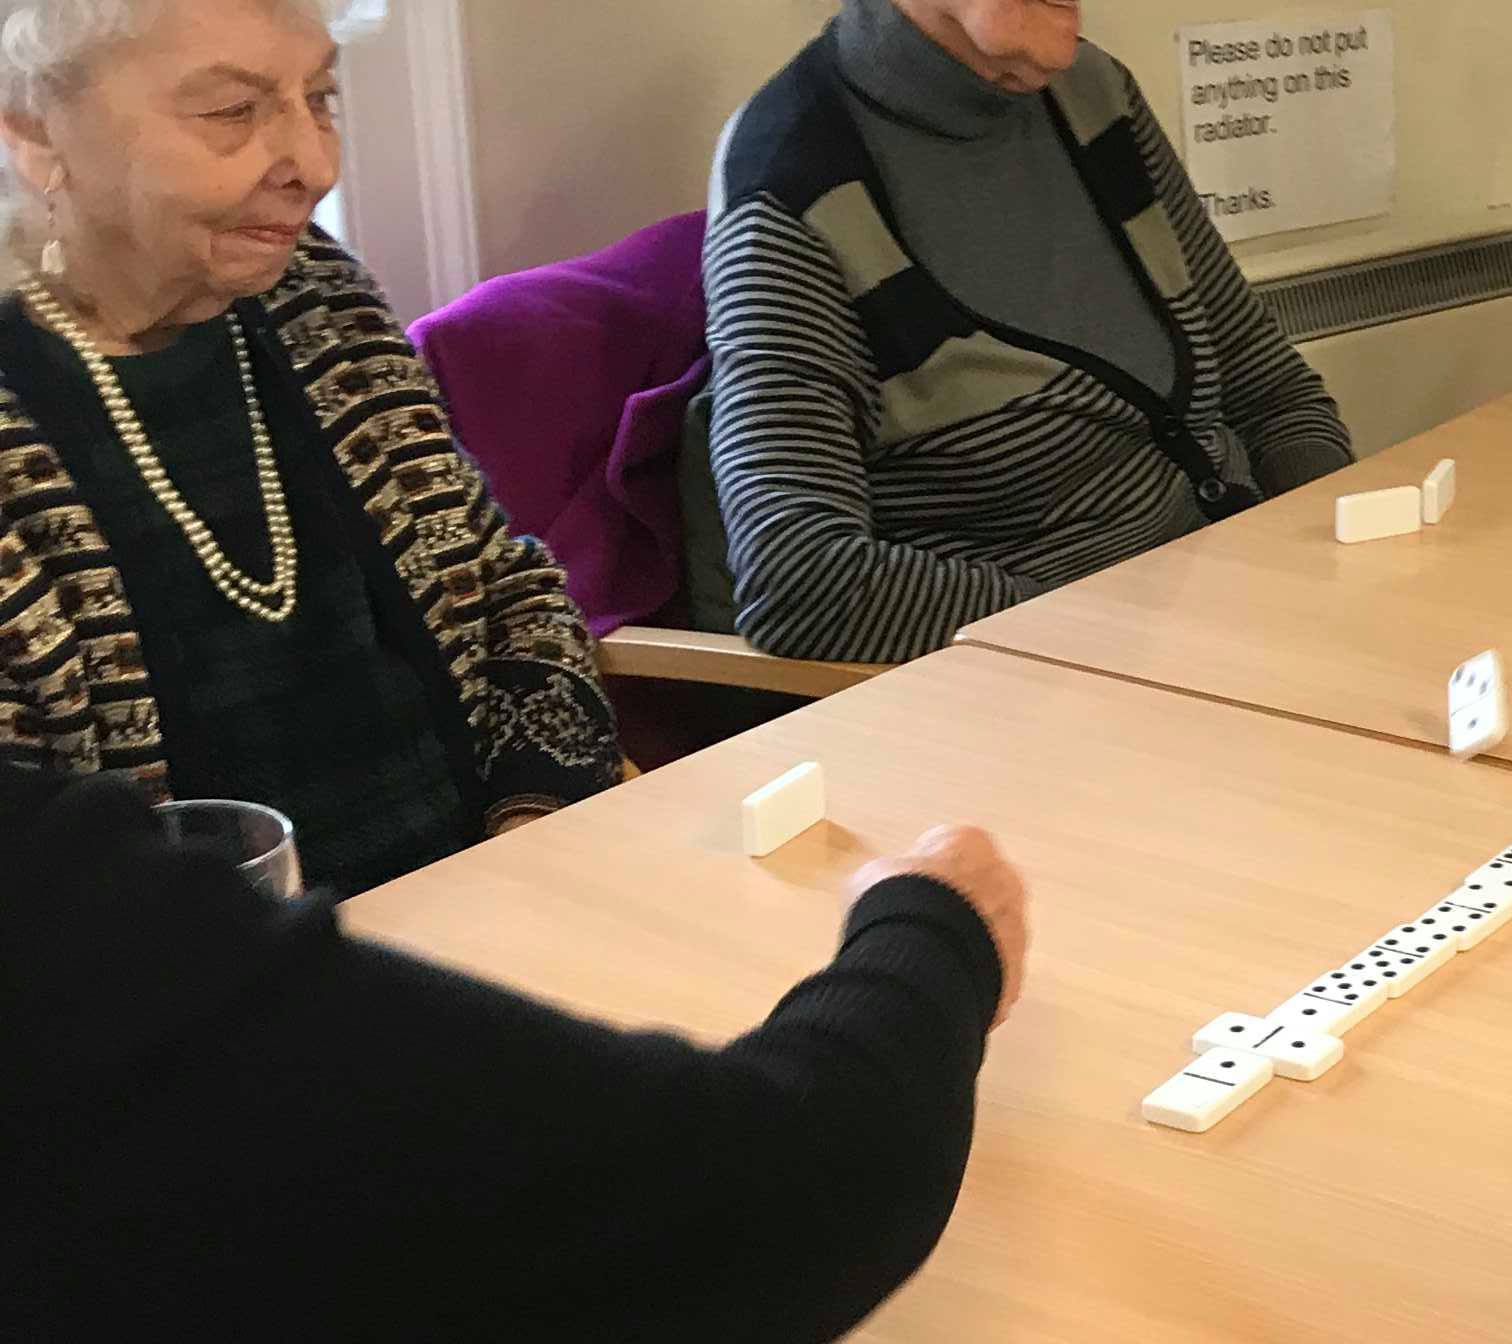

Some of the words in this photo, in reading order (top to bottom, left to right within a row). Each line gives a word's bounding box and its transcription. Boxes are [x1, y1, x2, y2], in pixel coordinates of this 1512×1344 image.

[1187, 39, 1261, 67] Please
[1264, 31, 1294, 59] do
[1298, 28, 1333, 56] not
[1334, 24, 1369, 58] put
[1190, 73, 1279, 110] anything
[1283, 71, 1312, 94] on
[1313, 64, 1352, 91] this
